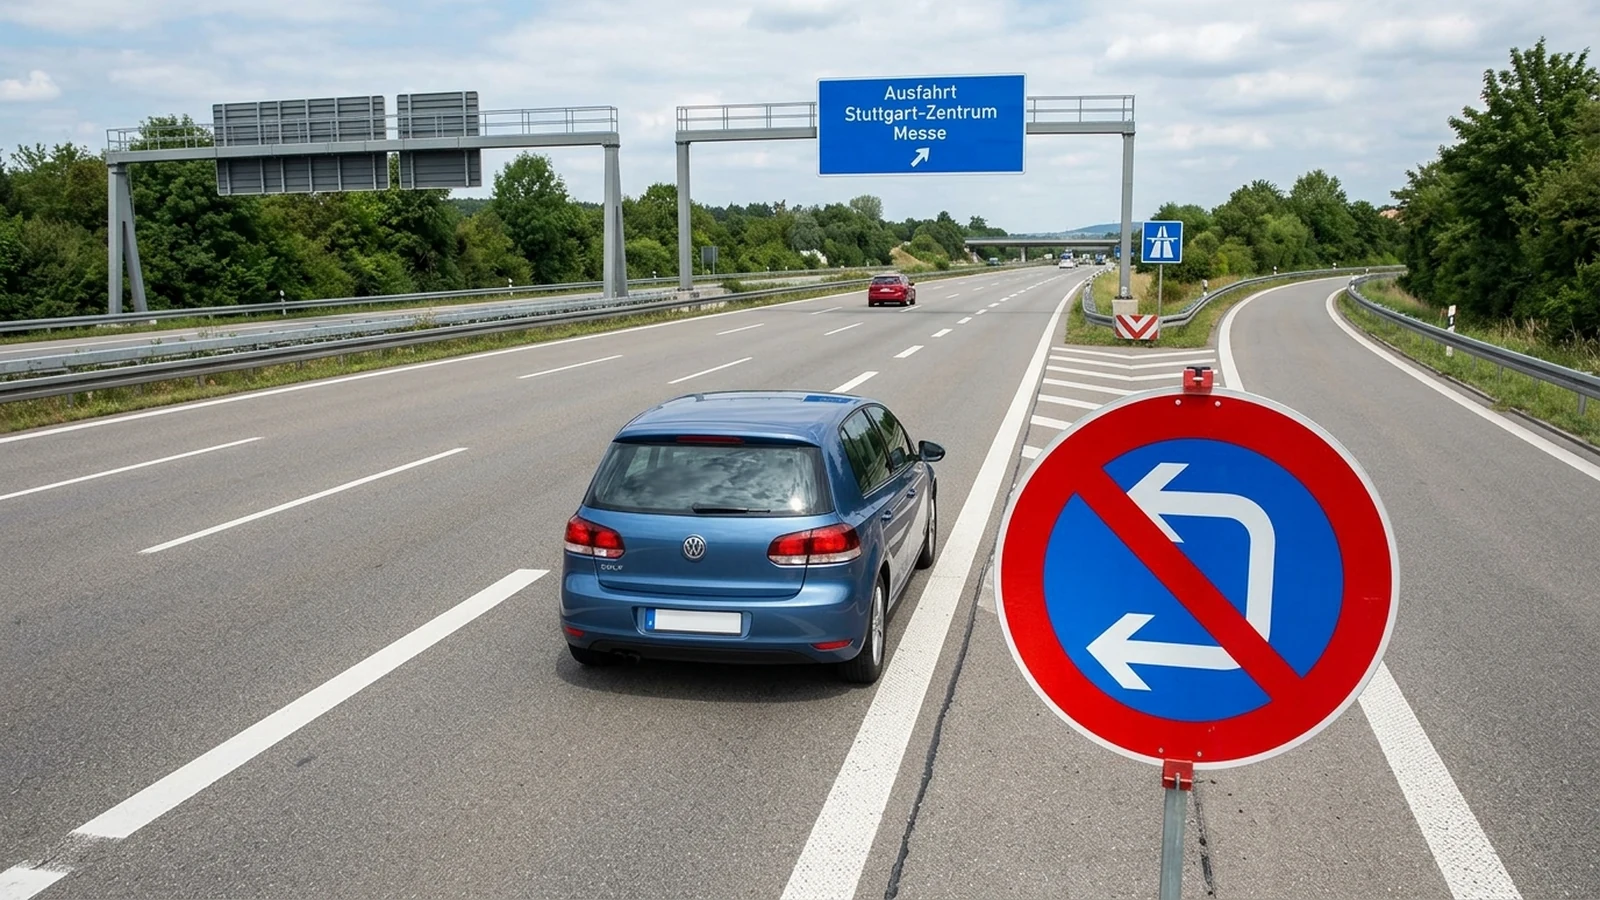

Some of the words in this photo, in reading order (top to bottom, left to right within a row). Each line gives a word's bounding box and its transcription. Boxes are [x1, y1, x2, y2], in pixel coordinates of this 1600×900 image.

[884, 85, 957, 100] Ausfahrt
[844, 105, 997, 124] Stuttgart-Zentrum
[893, 126, 947, 140] Messe
